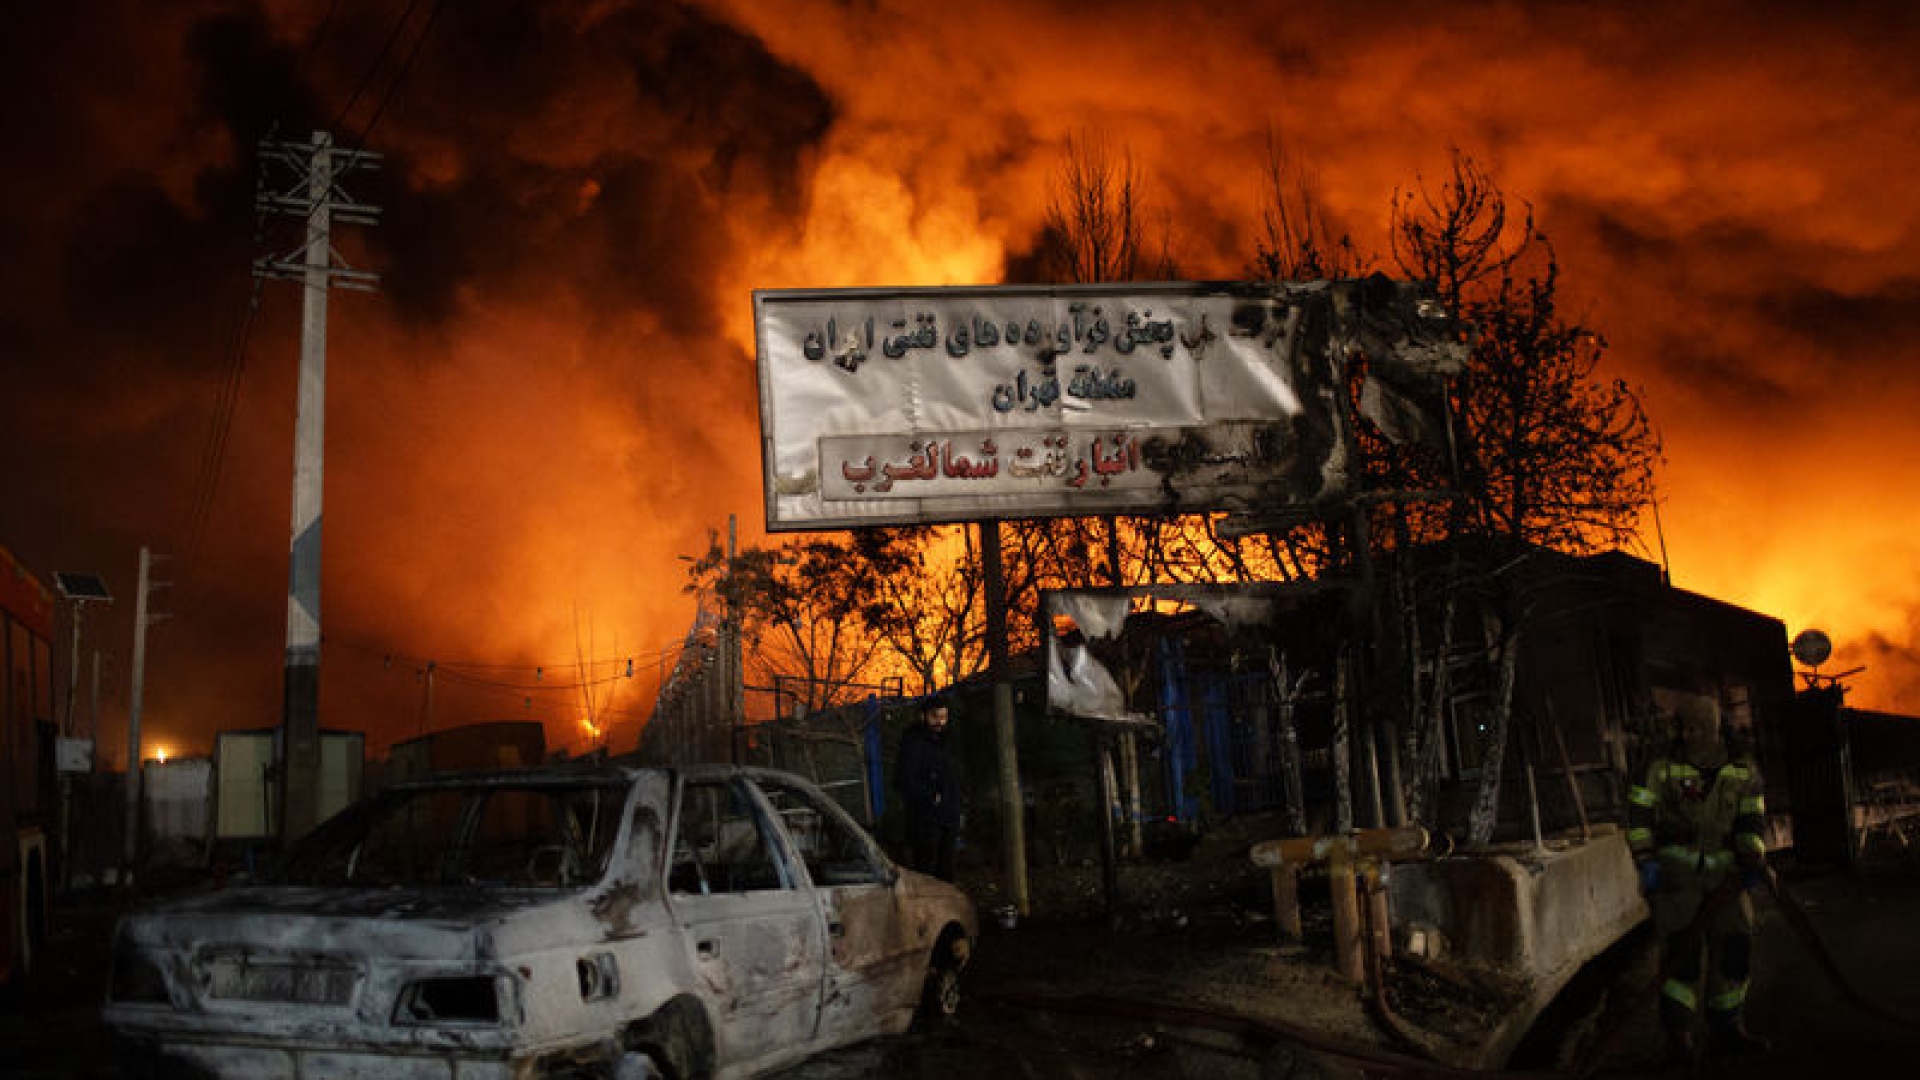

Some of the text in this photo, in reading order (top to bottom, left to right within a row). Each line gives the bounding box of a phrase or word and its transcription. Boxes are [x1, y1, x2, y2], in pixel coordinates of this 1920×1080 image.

[882, 311, 937, 359] نفتی
[1005, 302, 1110, 355] فرآوده
[1114, 308, 1174, 360] پخش
[993, 364, 1136, 413] منطقه تهران
[1065, 435, 1140, 488] انبار
